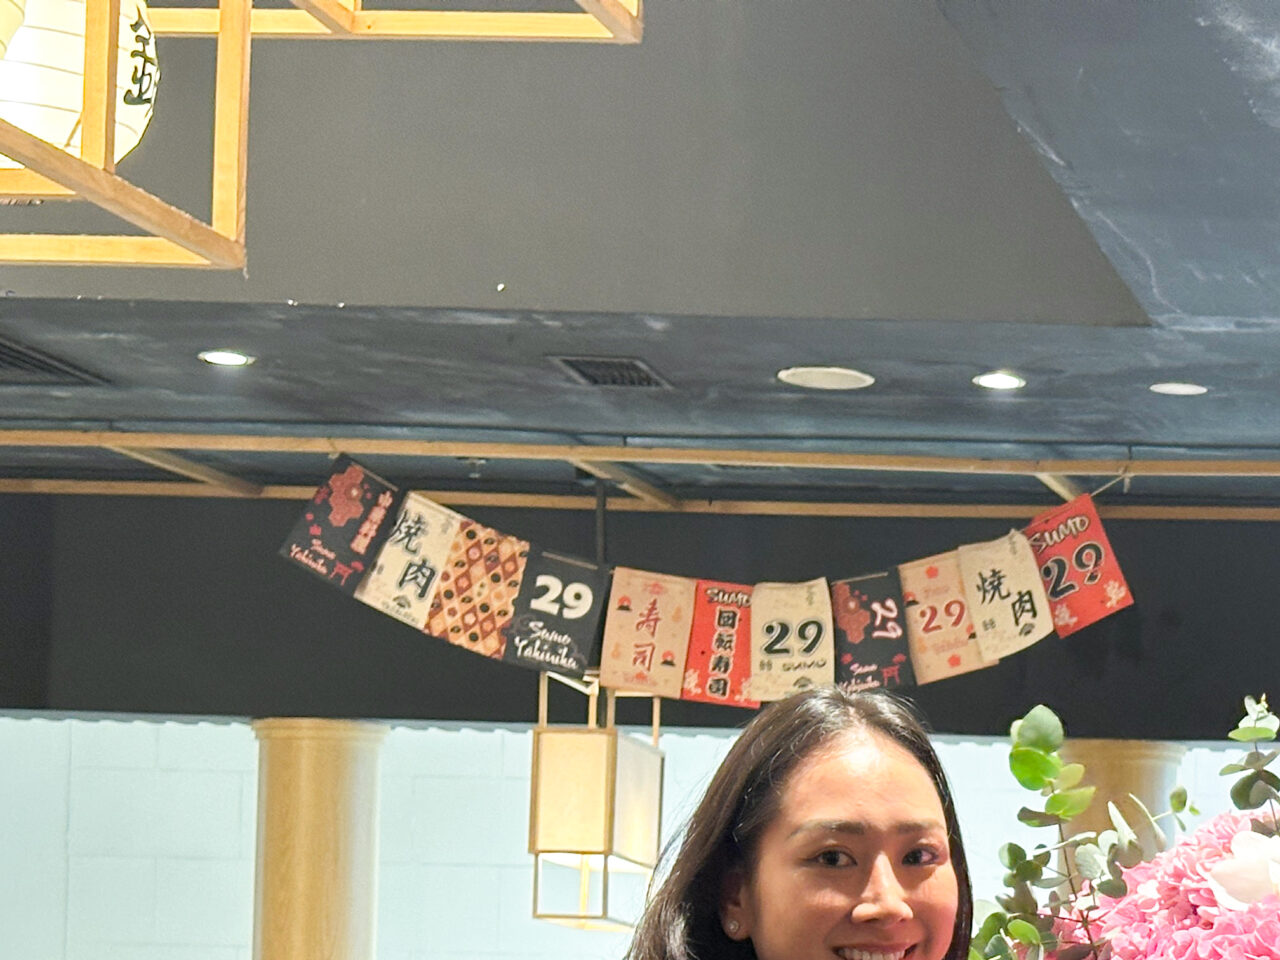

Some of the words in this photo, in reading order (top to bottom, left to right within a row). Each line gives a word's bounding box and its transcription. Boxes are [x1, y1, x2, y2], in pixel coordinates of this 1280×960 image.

[1029, 515, 1089, 554] SUMO
[1041, 541, 1104, 602] 29
[530, 574, 594, 620] 29
[919, 600, 966, 633] 29
[976, 567, 1038, 627] 焼肉
[632, 598, 661, 672] 寿司
[763, 619, 824, 655] 29
